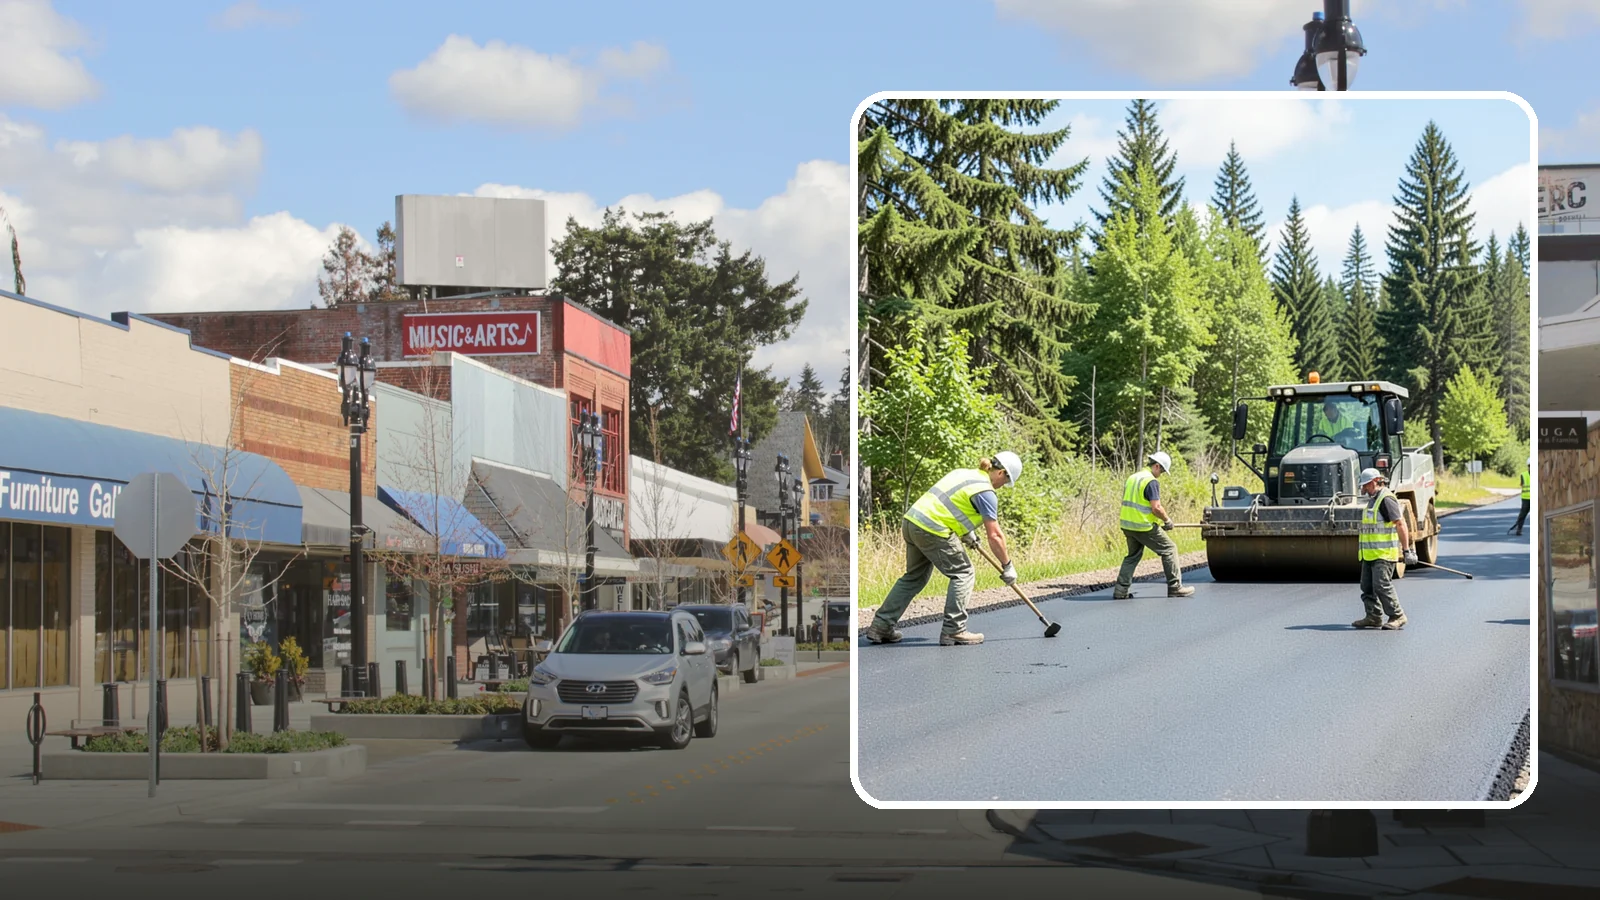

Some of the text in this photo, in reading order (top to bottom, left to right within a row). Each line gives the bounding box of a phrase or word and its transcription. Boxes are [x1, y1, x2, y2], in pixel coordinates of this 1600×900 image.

[0, 471, 122, 519] Furniture Gal
[453, 563, 479, 574] SUSHI
